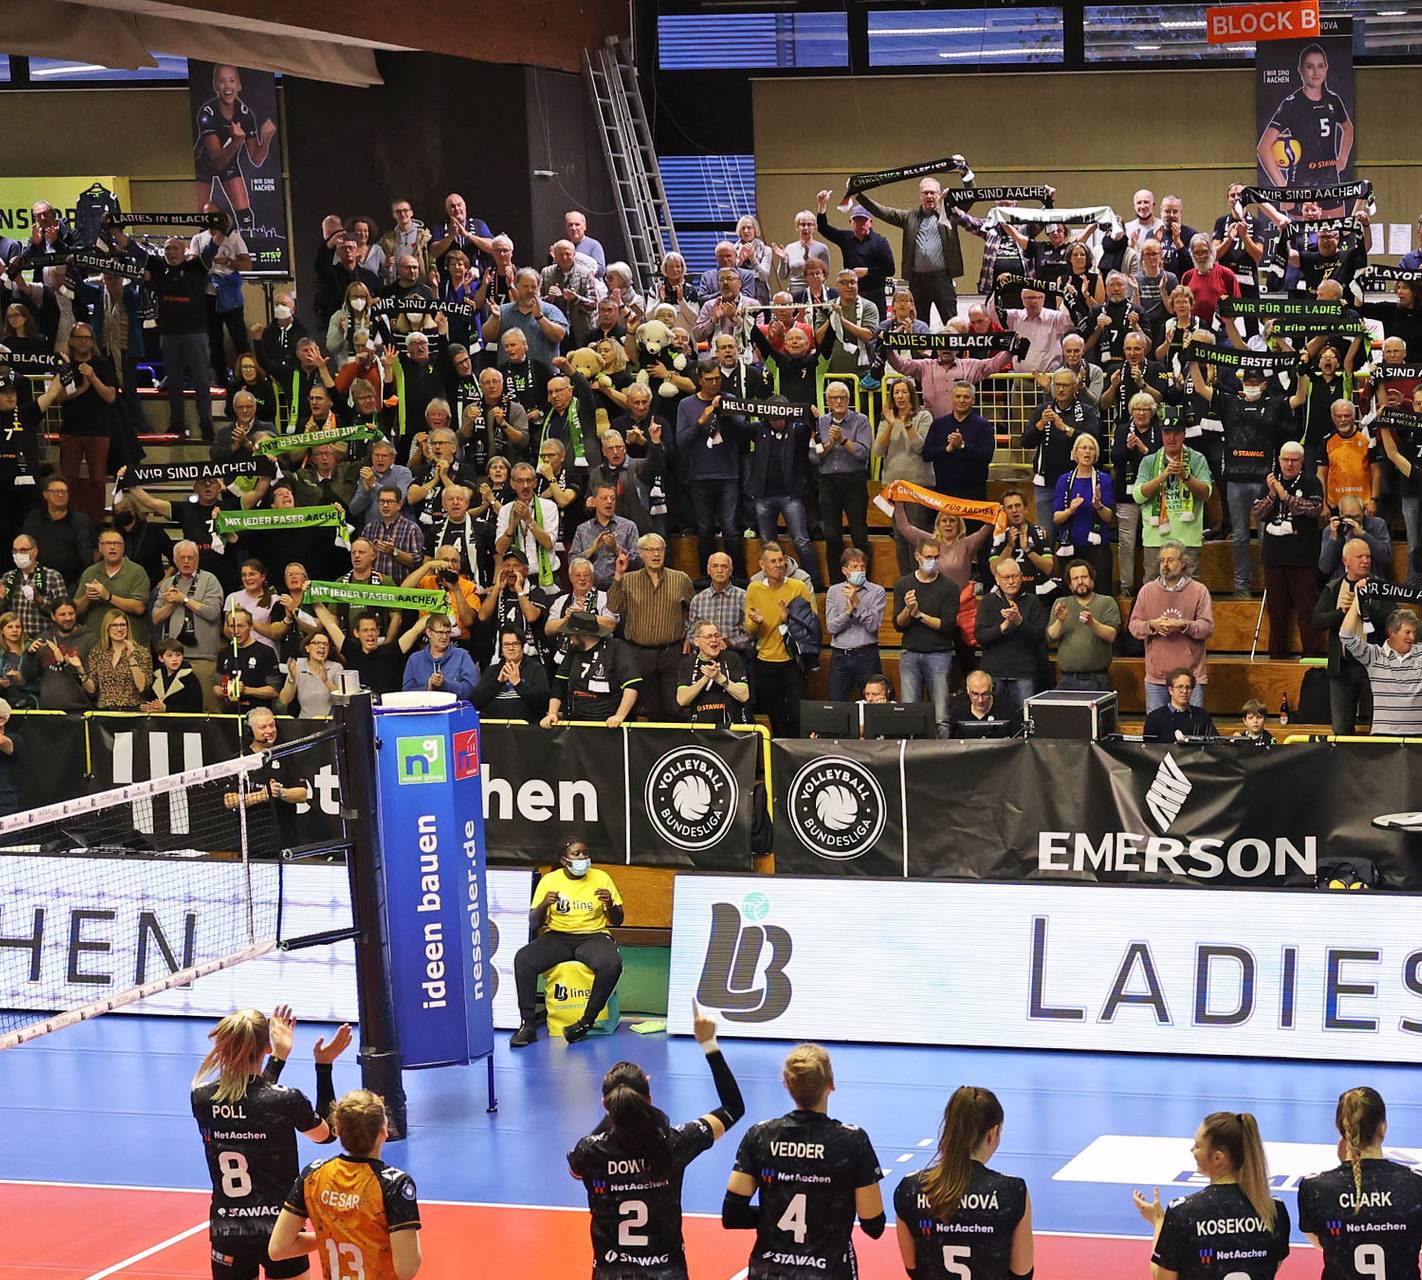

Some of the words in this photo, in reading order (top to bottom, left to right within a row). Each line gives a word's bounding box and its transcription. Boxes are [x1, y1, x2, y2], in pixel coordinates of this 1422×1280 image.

[1212, 10, 1293, 35] BLOCK
[1301, 8, 1316, 28] B
[1266, 75, 1290, 83] AACHEN
[1319, 118, 1331, 137] 5
[952, 188, 974, 200] WIR
[977, 188, 1003, 199] SIND
[1259, 188, 1282, 200] WIR
[1284, 188, 1312, 199] SIND
[1314, 185, 1362, 198] AACHEN
[156, 214, 167, 223] IN
[171, 214, 210, 224] BLACK
[76, 254, 111, 269] LADIES
[112, 262, 125, 272] IN
[398, 299, 426, 310] SIND
[1232, 302, 1256, 312] WIR
[1258, 301, 1281, 315] FÜR
[1284, 303, 1302, 314] DIE
[1304, 304, 1342, 316] LADIES
[884, 335, 928, 348] LADIES
[930, 335, 946, 347] IN
[949, 335, 994, 348] BLACK
[12, 354, 55, 366] BLACK
[1207, 350, 1239, 366] JAHRE
[1241, 356, 1273, 368] ERSTE
[1386, 367, 1415, 378] SIND
[722, 400, 755, 413] HELLO
[756, 403, 803, 417] EUROPE!
[4, 428, 14, 441] 7
[134, 466, 164, 481] WIR
[167, 466, 198, 480] SIND
[202, 461, 258, 478] AACHEN
[224, 516, 242, 526] MIT
[273, 514, 305, 526] FASER
[1016, 548, 1025, 563] 2
[309, 585, 329, 598] MIT
[329, 586, 360, 600] JEDER
[362, 590, 395, 602] FASER
[397, 594, 438, 606] AACHEN
[1382, 583, 1414, 601] SIND
[506, 607, 516, 622] 4
[658, 759, 724, 794] VOLLEYBALL
[801, 768, 870, 801] VOLLEYBALL
[660, 807, 724, 838] BUNDESLIGA
[804, 817, 872, 847] BUNDESLIGA
[416, 814, 442, 913] bauen
[1038, 830, 1317, 879] EMERSON
[463, 818, 489, 1001] nesseler.de
[422, 920, 446, 1010] ideen
[212, 1104, 247, 1120] POLL
[214, 1130, 267, 1140] NetAachen
[770, 1140, 825, 1160] VEDDER
[218, 1151, 252, 1198] 8
[777, 1172, 832, 1184] NetAachen
[320, 1190, 360, 1210] CESAR
[1338, 1190, 1392, 1208] CLARK
[618, 1200, 650, 1246] 2
[776, 1193, 808, 1244] 4
[1346, 1222, 1407, 1233] NetAachen
[936, 1222, 994, 1234] NetAachen
[324, 1238, 366, 1280] 13
[772, 1252, 828, 1270] STAWAG
[942, 1245, 972, 1280] 5
[1216, 1248, 1268, 1260] NetAachen
[1353, 1243, 1387, 1280] 9
